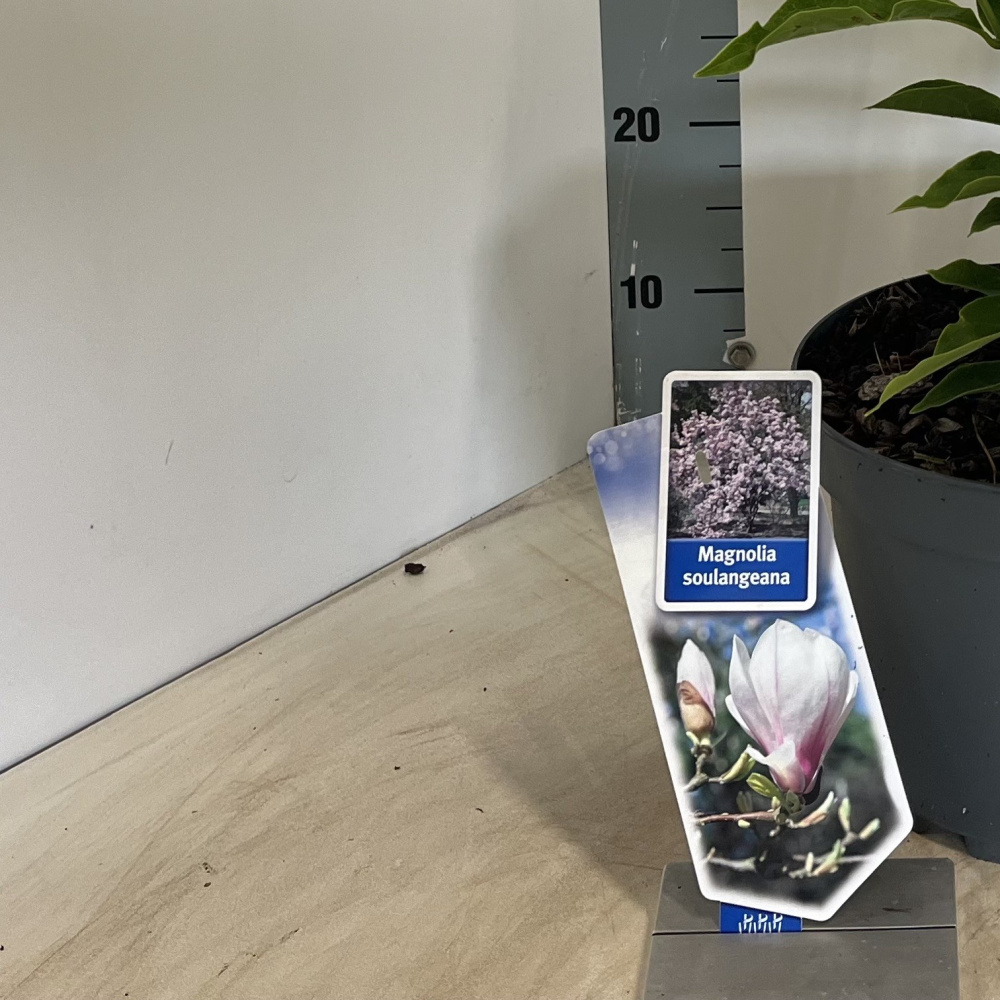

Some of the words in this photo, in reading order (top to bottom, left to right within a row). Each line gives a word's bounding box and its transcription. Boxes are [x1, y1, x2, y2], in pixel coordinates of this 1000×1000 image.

[613, 107, 661, 142] 20
[620, 275, 663, 309] 10
[698, 545, 776, 566] Magnolia
[682, 568, 790, 589] soulangeana
